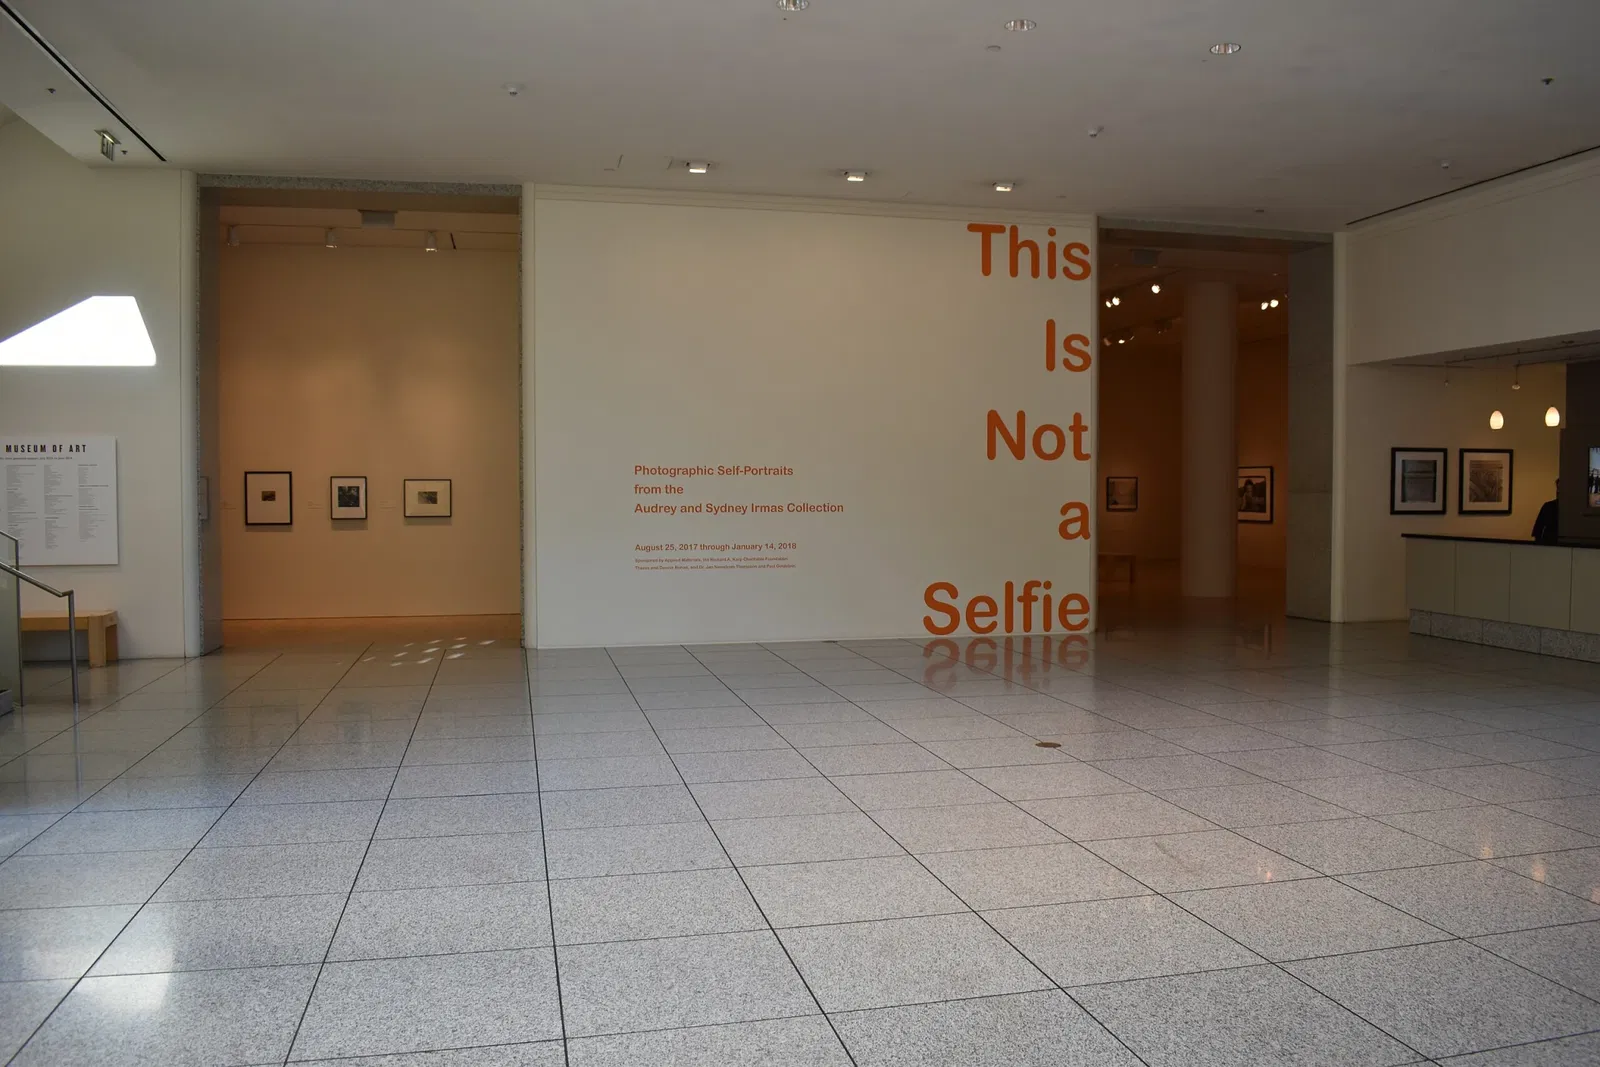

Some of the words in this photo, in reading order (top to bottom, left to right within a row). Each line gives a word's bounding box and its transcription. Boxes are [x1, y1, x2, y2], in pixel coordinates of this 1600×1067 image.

[967, 223, 1092, 281] This
[1046, 319, 1092, 372] Is
[5, 444, 47, 453] MUSEUM
[52, 444, 63, 453] OF
[68, 444, 87, 453] ART
[987, 410, 1091, 461] Not
[634, 465, 714, 478] Photographic
[717, 465, 793, 476] Self-Portraits
[634, 484, 662, 495] from
[665, 484, 684, 495] the
[634, 503, 677, 516] Audrey
[680, 503, 702, 513] and
[705, 503, 748, 516] Sydney
[751, 503, 784, 513] Irmas
[786, 502, 844, 513] Collection
[1059, 502, 1091, 540] a
[635, 544, 663, 553] August
[665, 544, 677, 552] 25,
[679, 543, 698, 551] 2017
[699, 543, 730, 553] through
[732, 543, 763, 552] January
[765, 543, 776, 551] 14,
[923, 581, 1090, 635] Selfie
